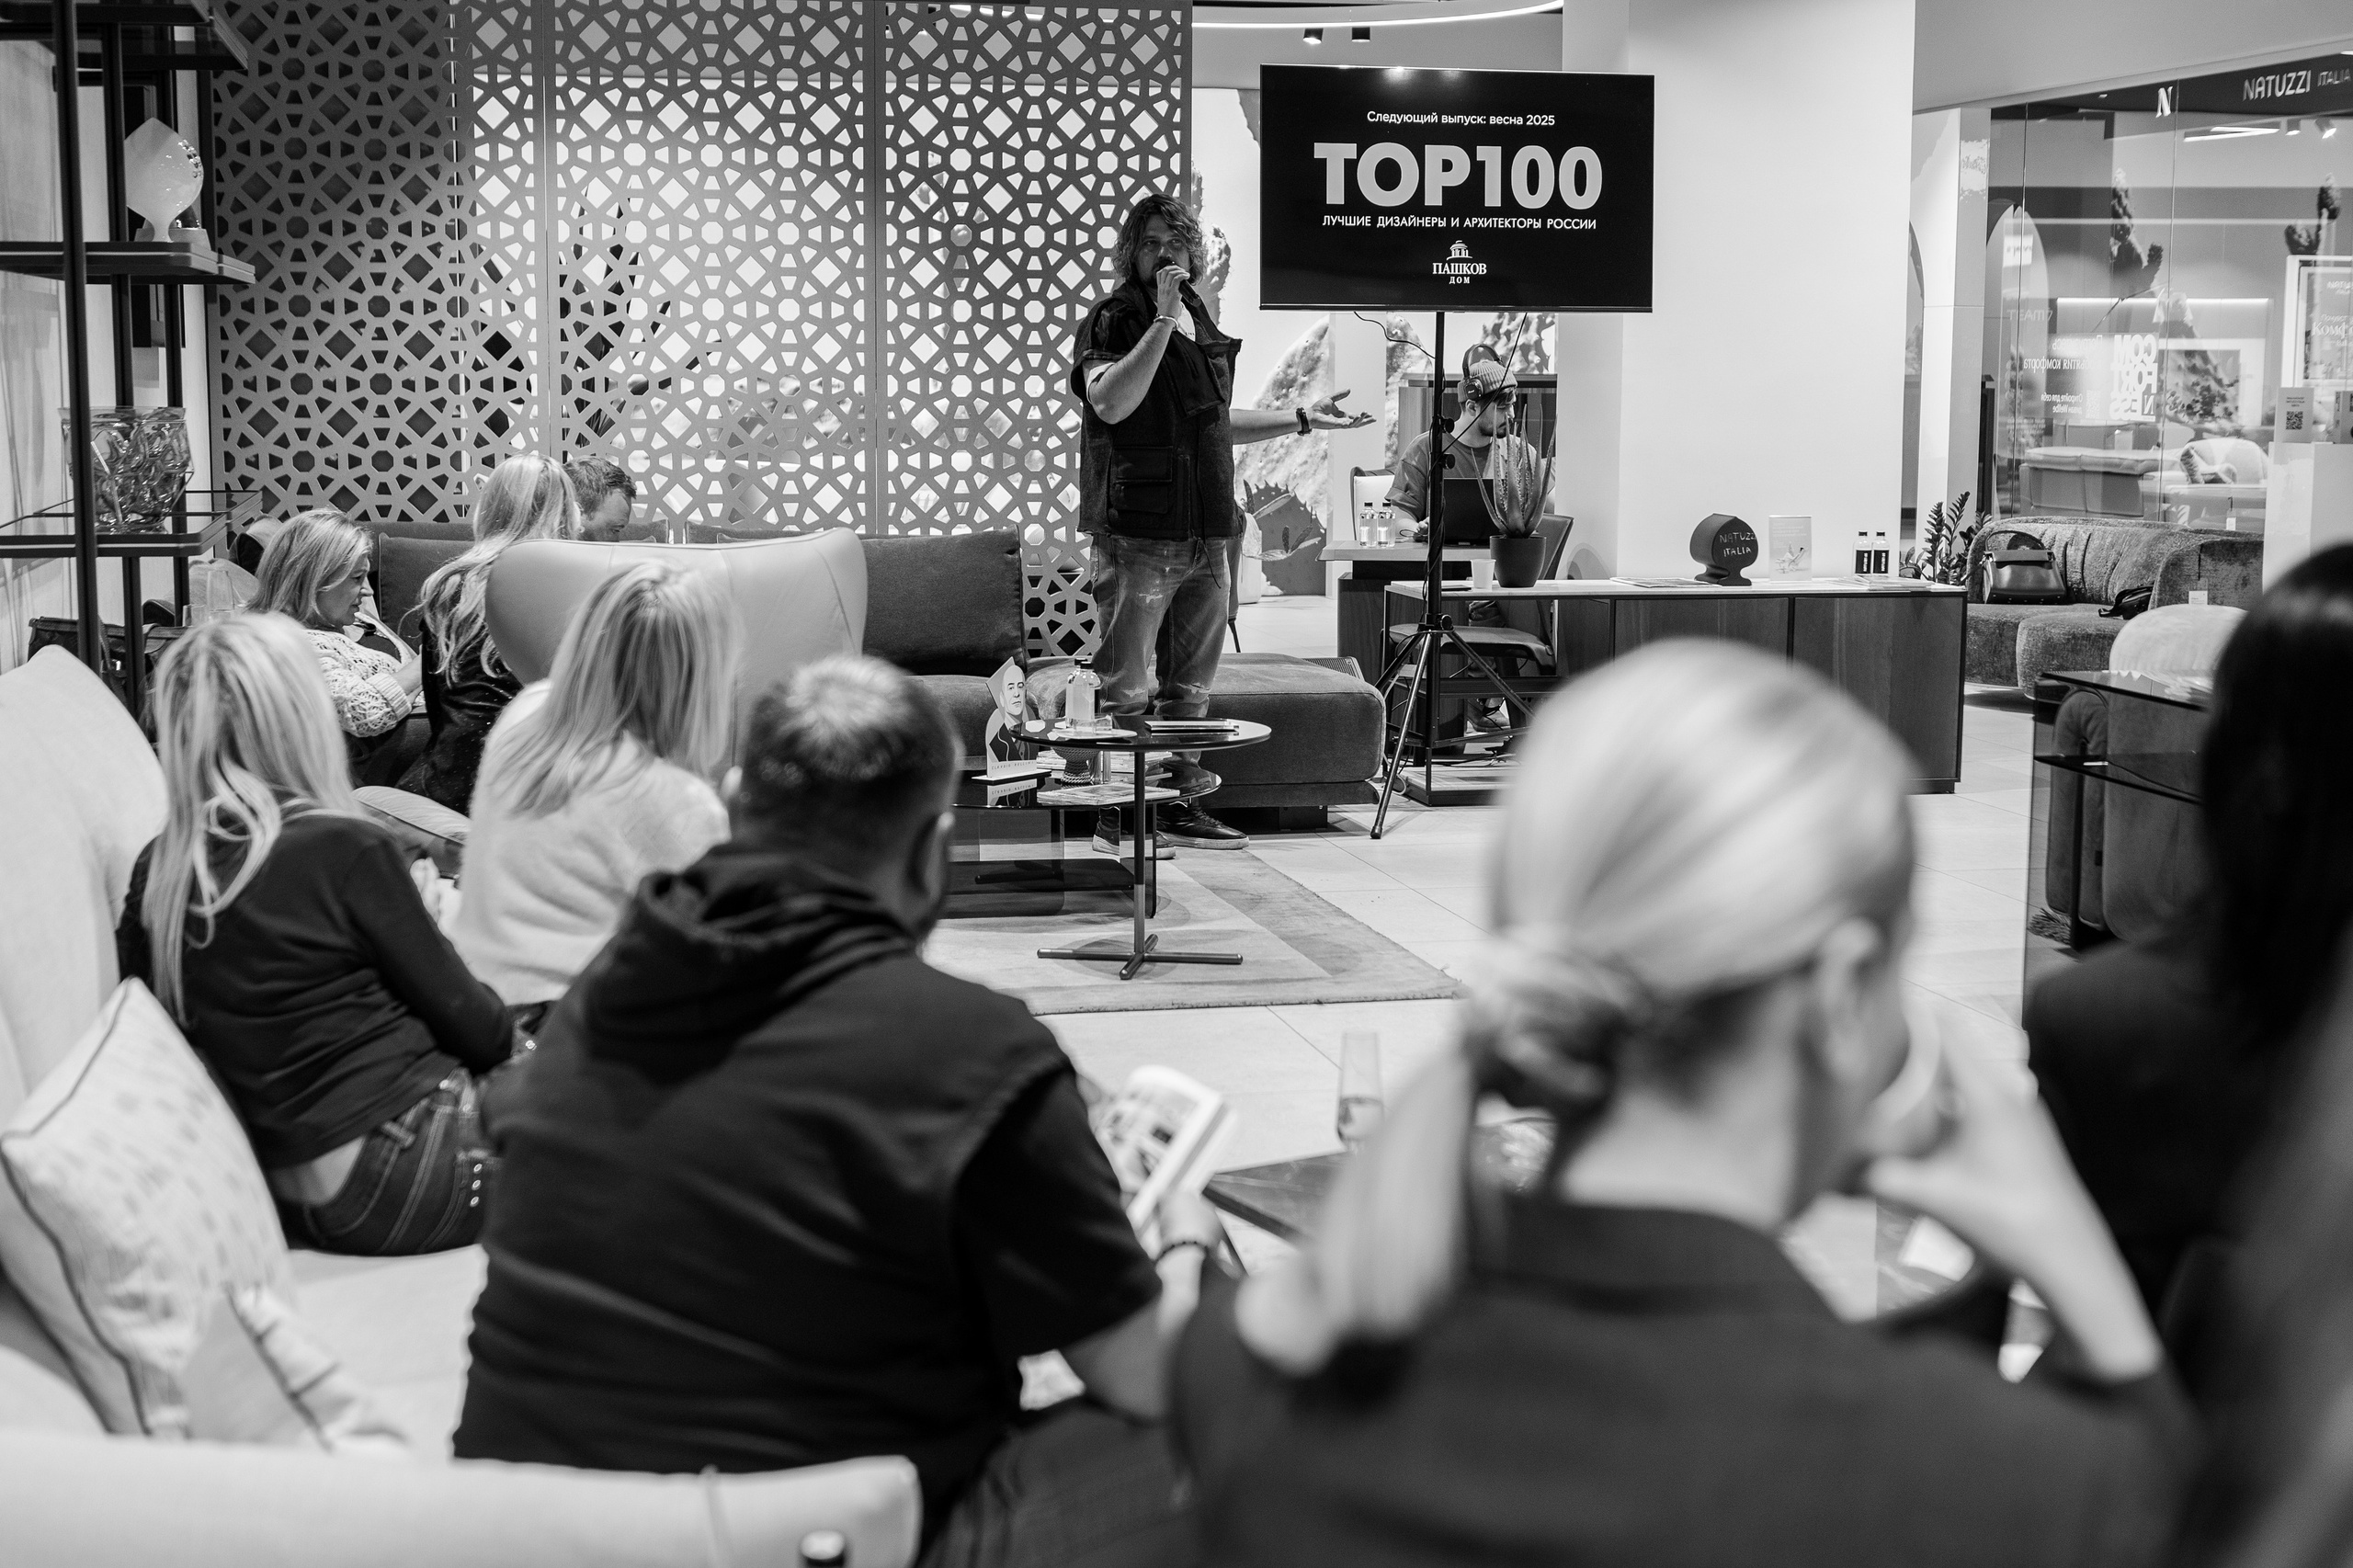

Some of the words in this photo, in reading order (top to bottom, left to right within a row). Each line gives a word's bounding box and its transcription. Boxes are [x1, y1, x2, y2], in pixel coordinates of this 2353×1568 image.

[2243, 70, 2312, 101] NATUZZI
[2317, 69, 2351, 87] ITALIA
[1367, 110, 1438, 125] Следующий
[1441, 114, 1486, 126] выпуск:
[1489, 115, 1524, 125] весна
[1526, 114, 1555, 126] 2025
[1322, 215, 1371, 227] ЛУЧШИЕ
[1376, 214, 1447, 229] ДИЗАЙНЕРЫ
[1450, 217, 1460, 228] И
[1462, 217, 1542, 229] АРХИТЕКТОРЫ
[1547, 218, 1597, 230] РОССИИ
[1432, 262, 1487, 275] ПАШКОВ
[1449, 276, 1471, 284] ДОМ
[1723, 546, 1752, 558] ITALIA
